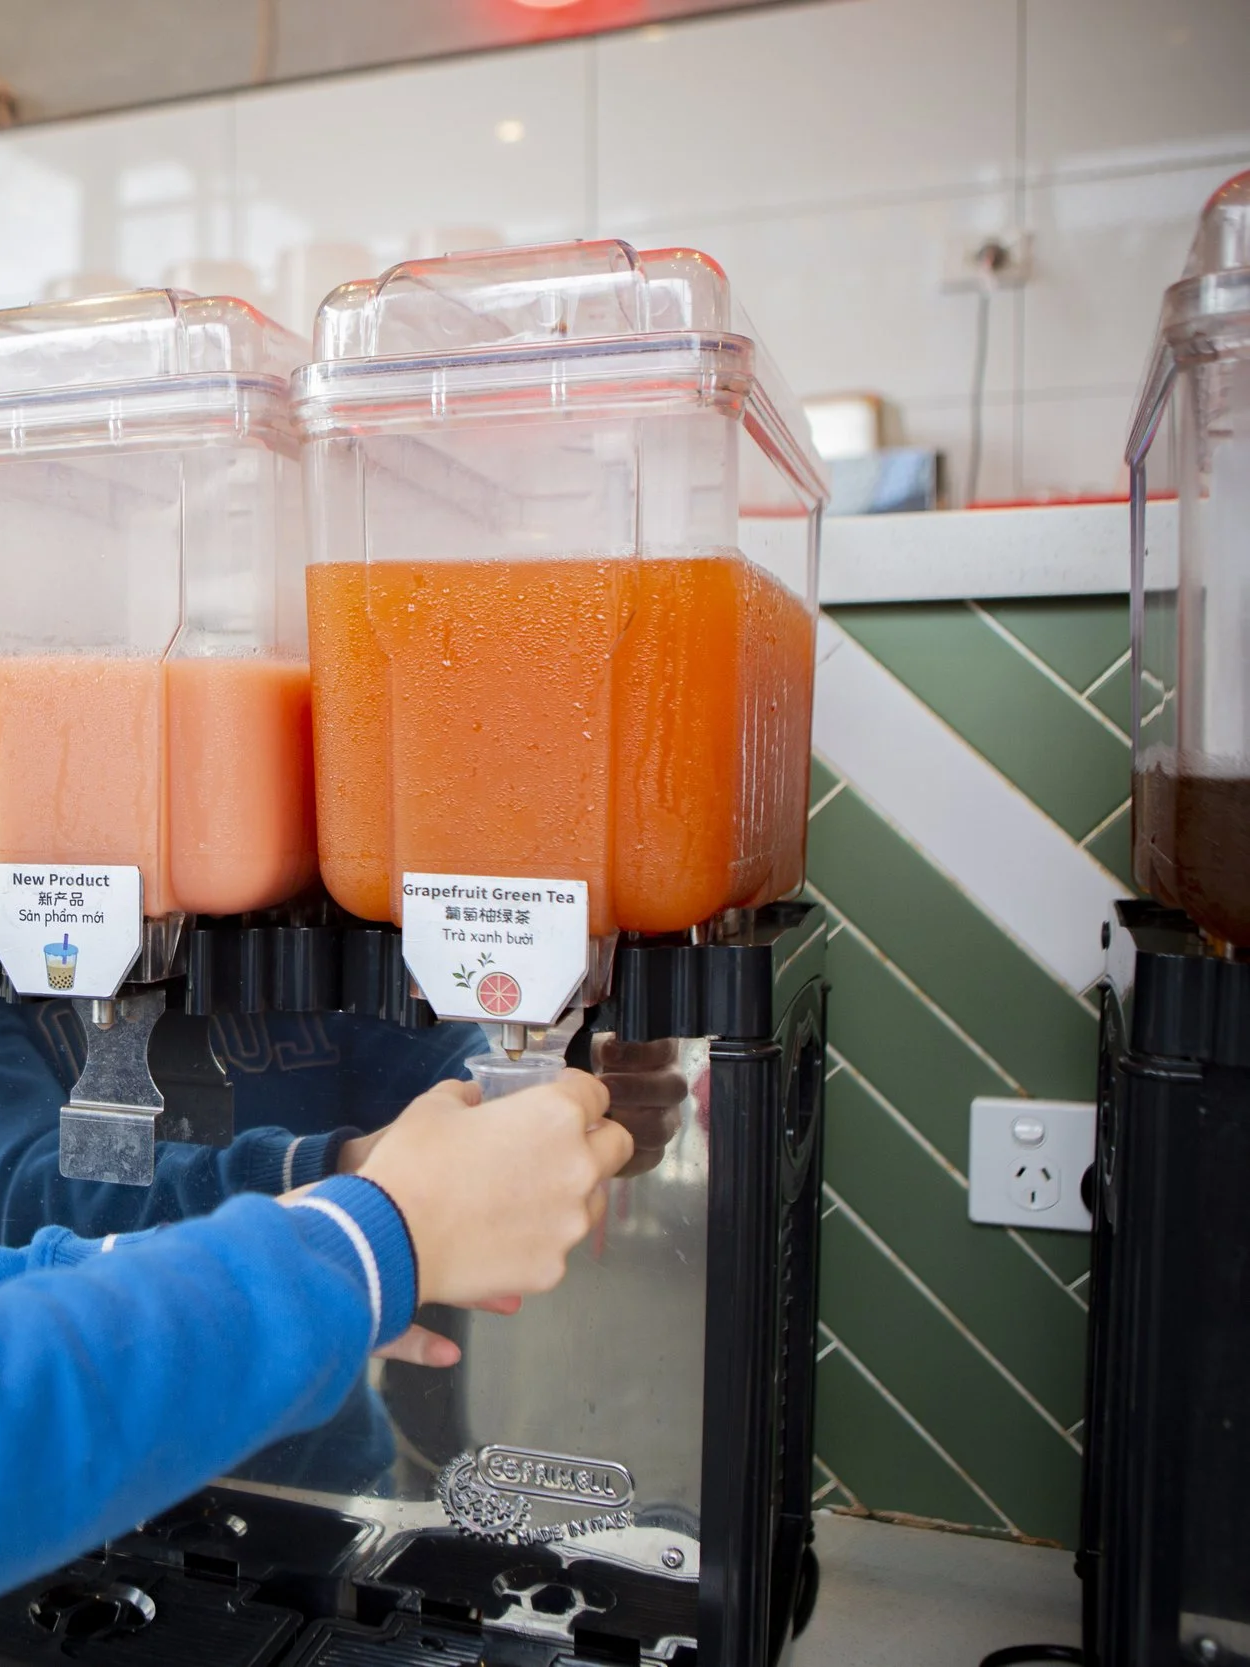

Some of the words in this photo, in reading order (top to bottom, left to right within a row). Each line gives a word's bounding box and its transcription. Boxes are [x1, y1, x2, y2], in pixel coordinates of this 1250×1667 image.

[12, 873, 45, 886] New
[49, 873, 110, 887] Product
[38, 891, 84, 907] 新产品
[403, 884, 488, 900] Grapefruit
[492, 888, 542, 902] Green
[546, 890, 576, 904] Tea
[19, 909, 41, 922] Sản
[45, 908, 78, 927] phẩm
[82, 911, 104, 924] mới
[442, 928, 466, 942] Trà
[470, 930, 503, 944] xanh
[517, 1524, 565, 1546] MADE
[566, 1519, 586, 1538] IN
[589, 1510, 635, 1533] ITALY
